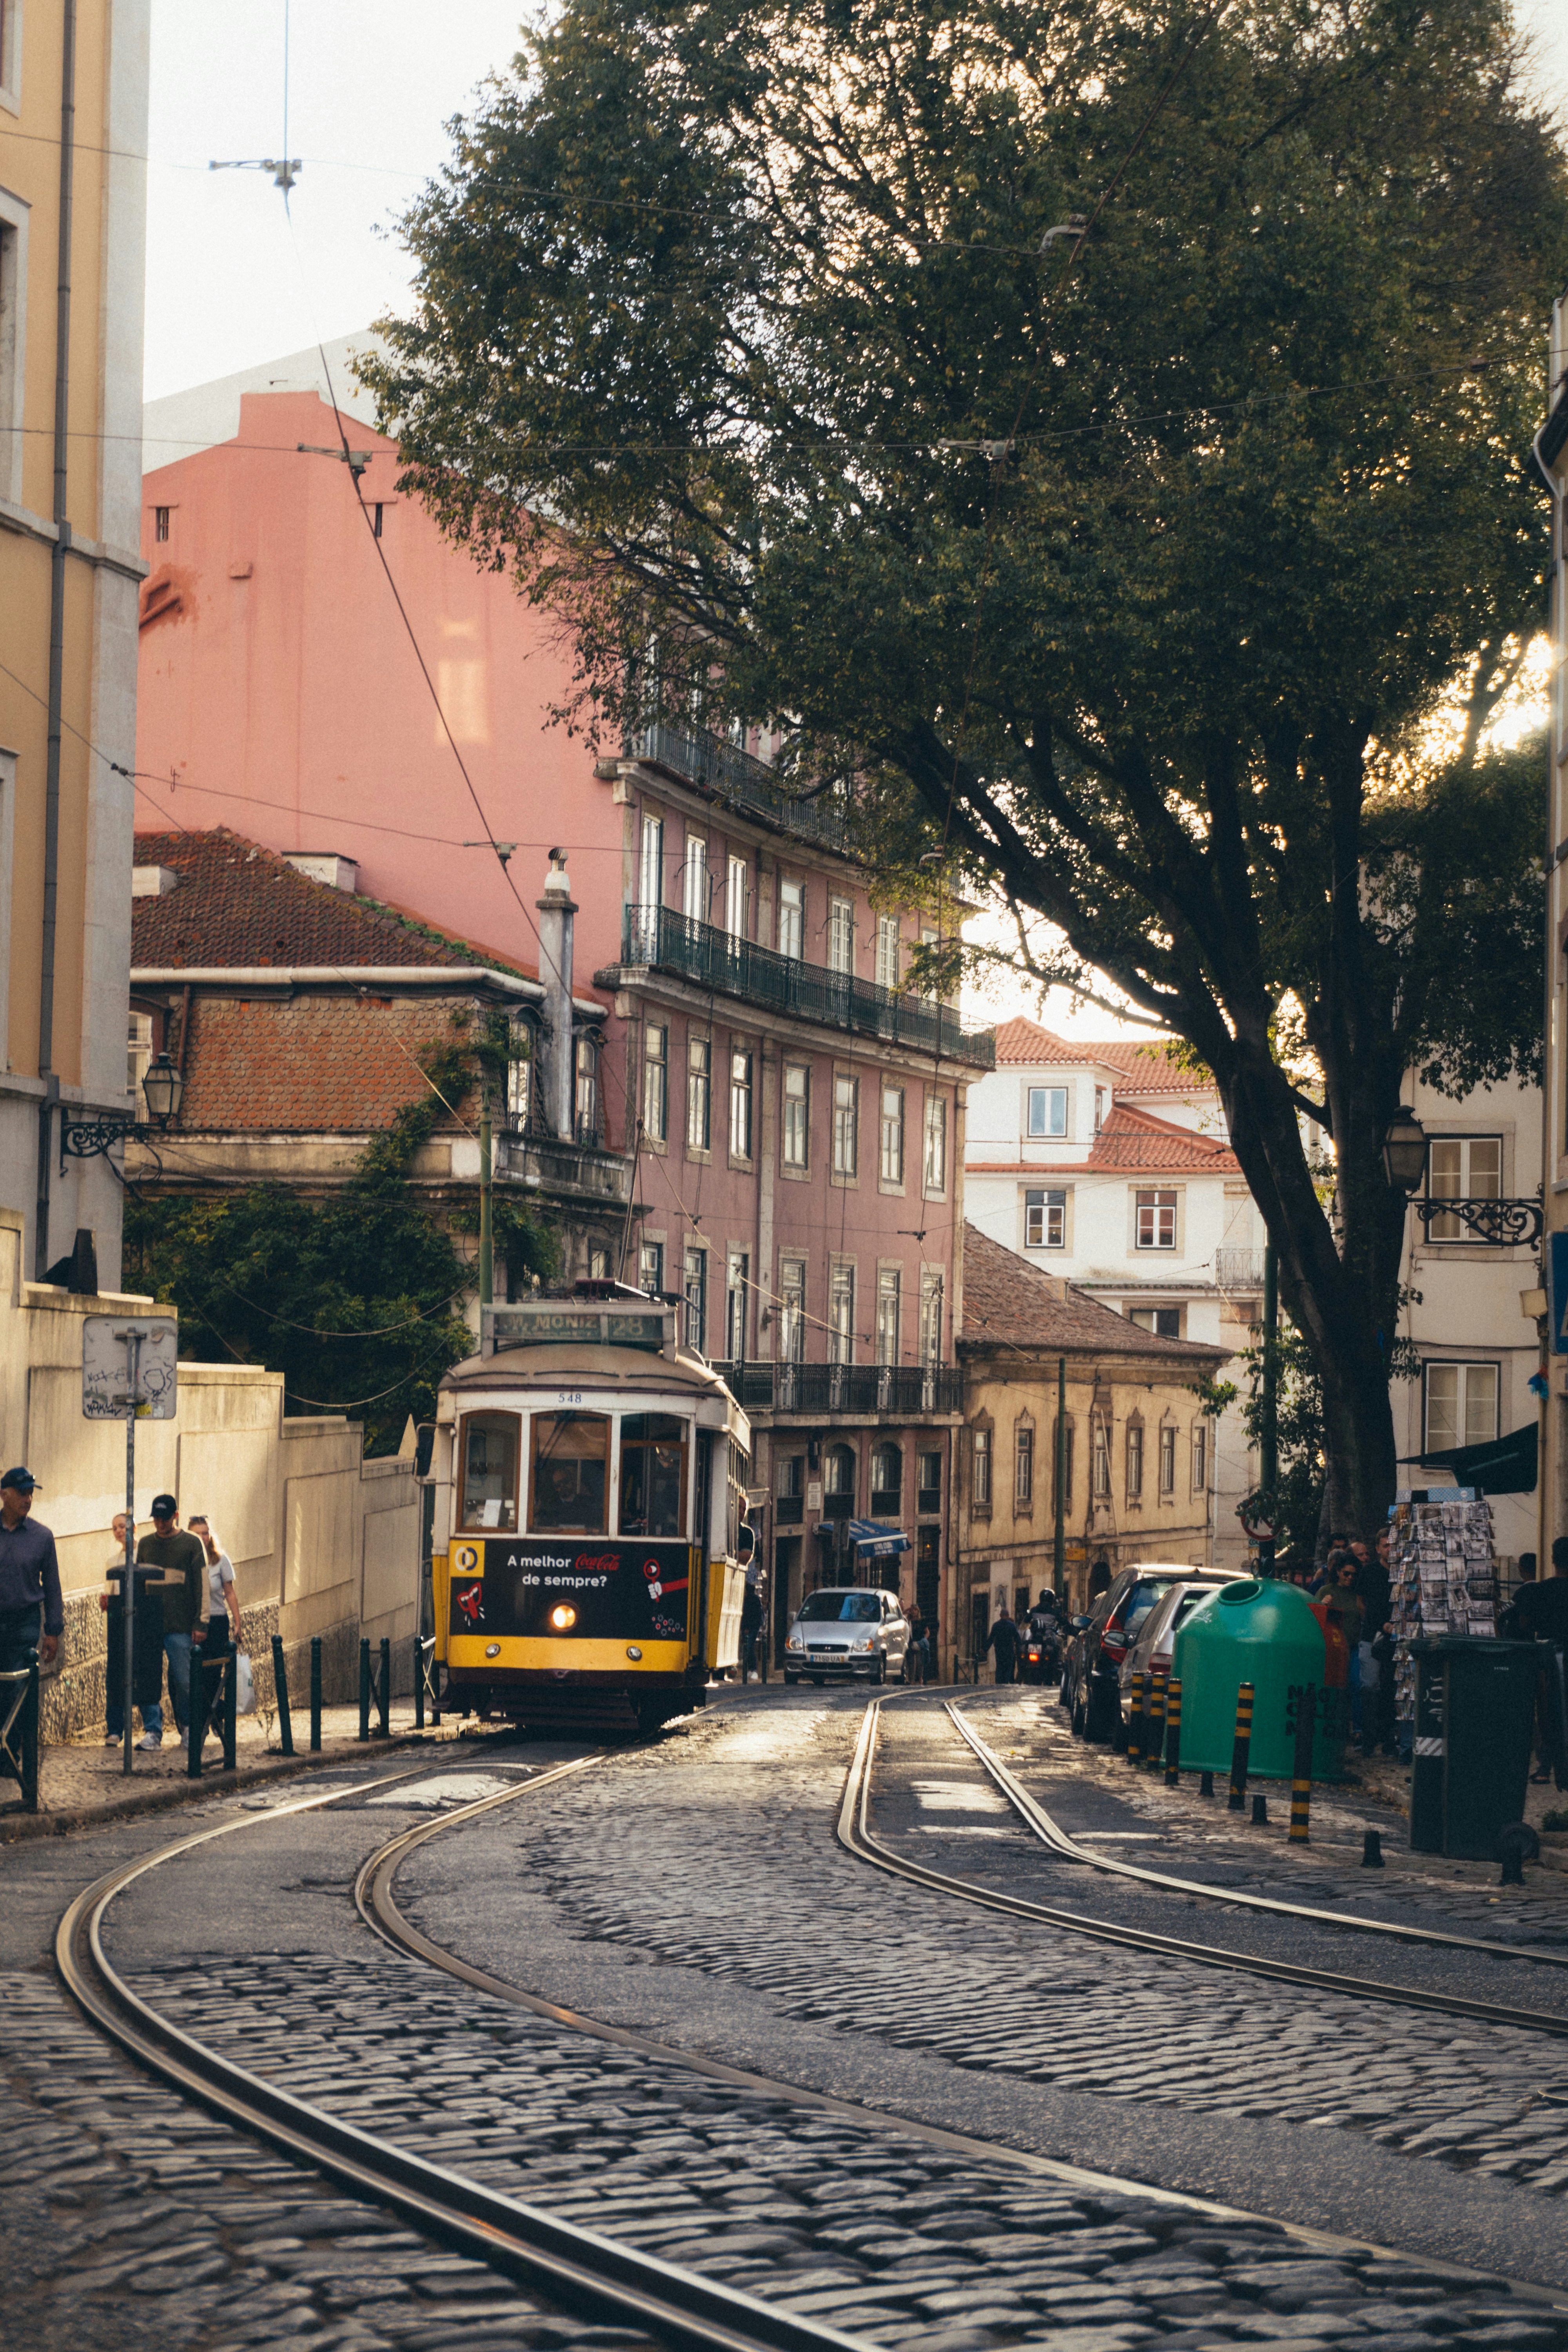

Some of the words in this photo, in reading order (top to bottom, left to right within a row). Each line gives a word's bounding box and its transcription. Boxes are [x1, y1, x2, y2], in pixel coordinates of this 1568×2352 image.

[535, 1314, 597, 1329] MONIZ
[612, 1316, 644, 1336] 28
[558, 1392, 581, 1403] 548
[507, 1555, 517, 1566] A
[520, 1555, 571, 1568] melhor
[522, 1573, 540, 1585] de
[544, 1575, 607, 1588] sempre?
